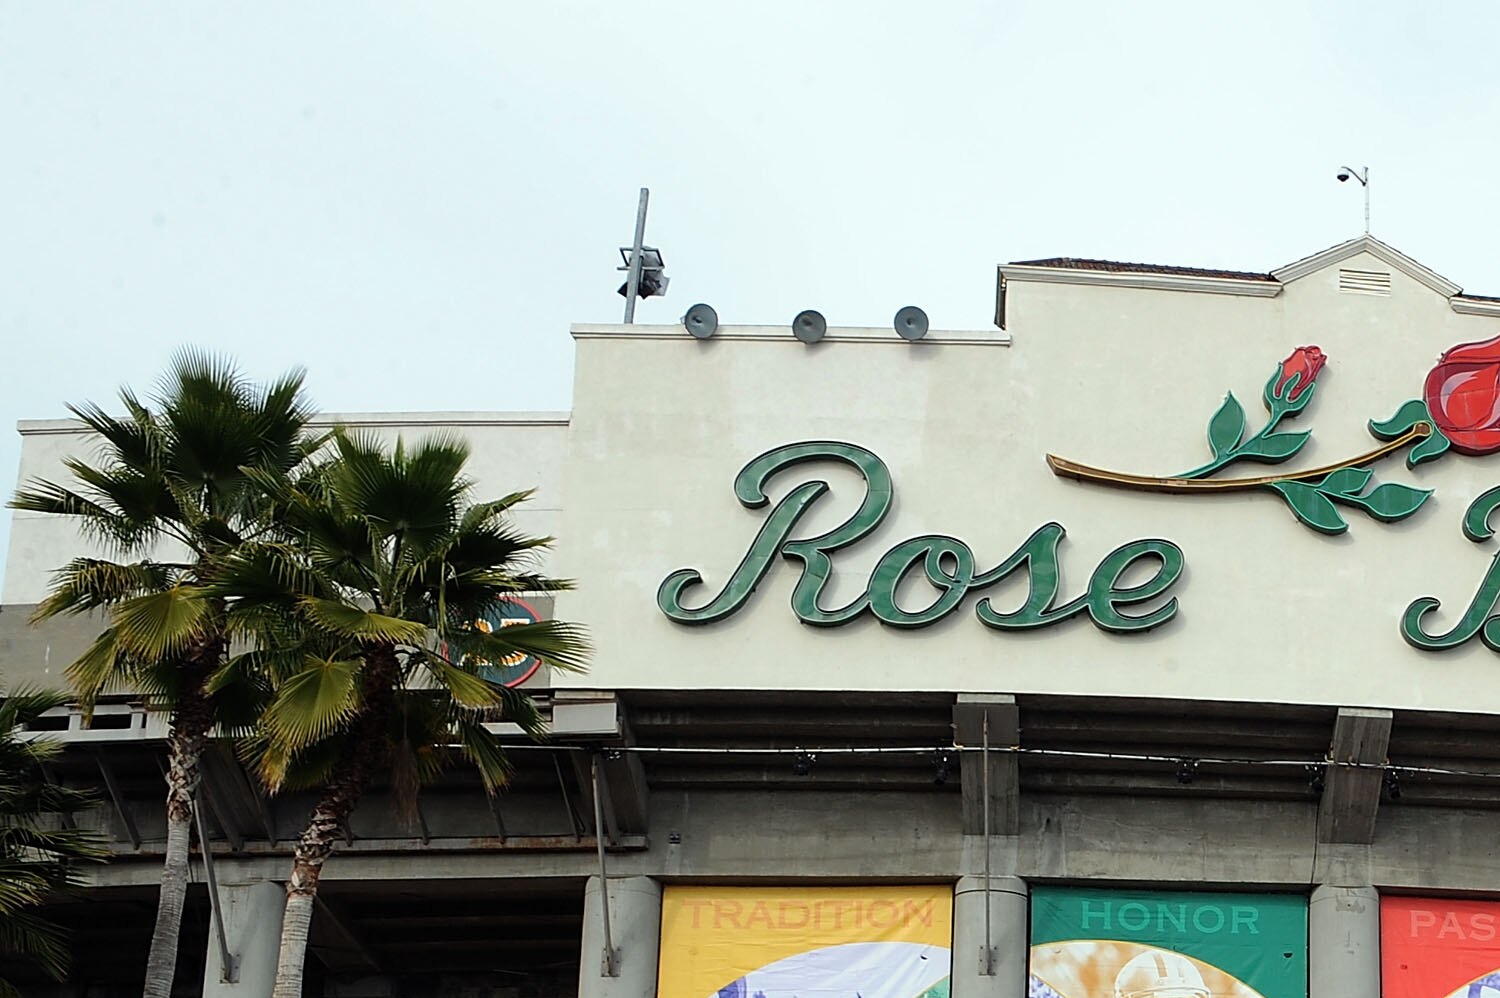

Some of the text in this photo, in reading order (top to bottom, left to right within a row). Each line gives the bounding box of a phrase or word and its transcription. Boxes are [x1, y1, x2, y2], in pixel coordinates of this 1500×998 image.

[656, 439, 1185, 633] Rose
[688, 898, 937, 930] TRADITION
[1081, 899, 1260, 935] HONOR
